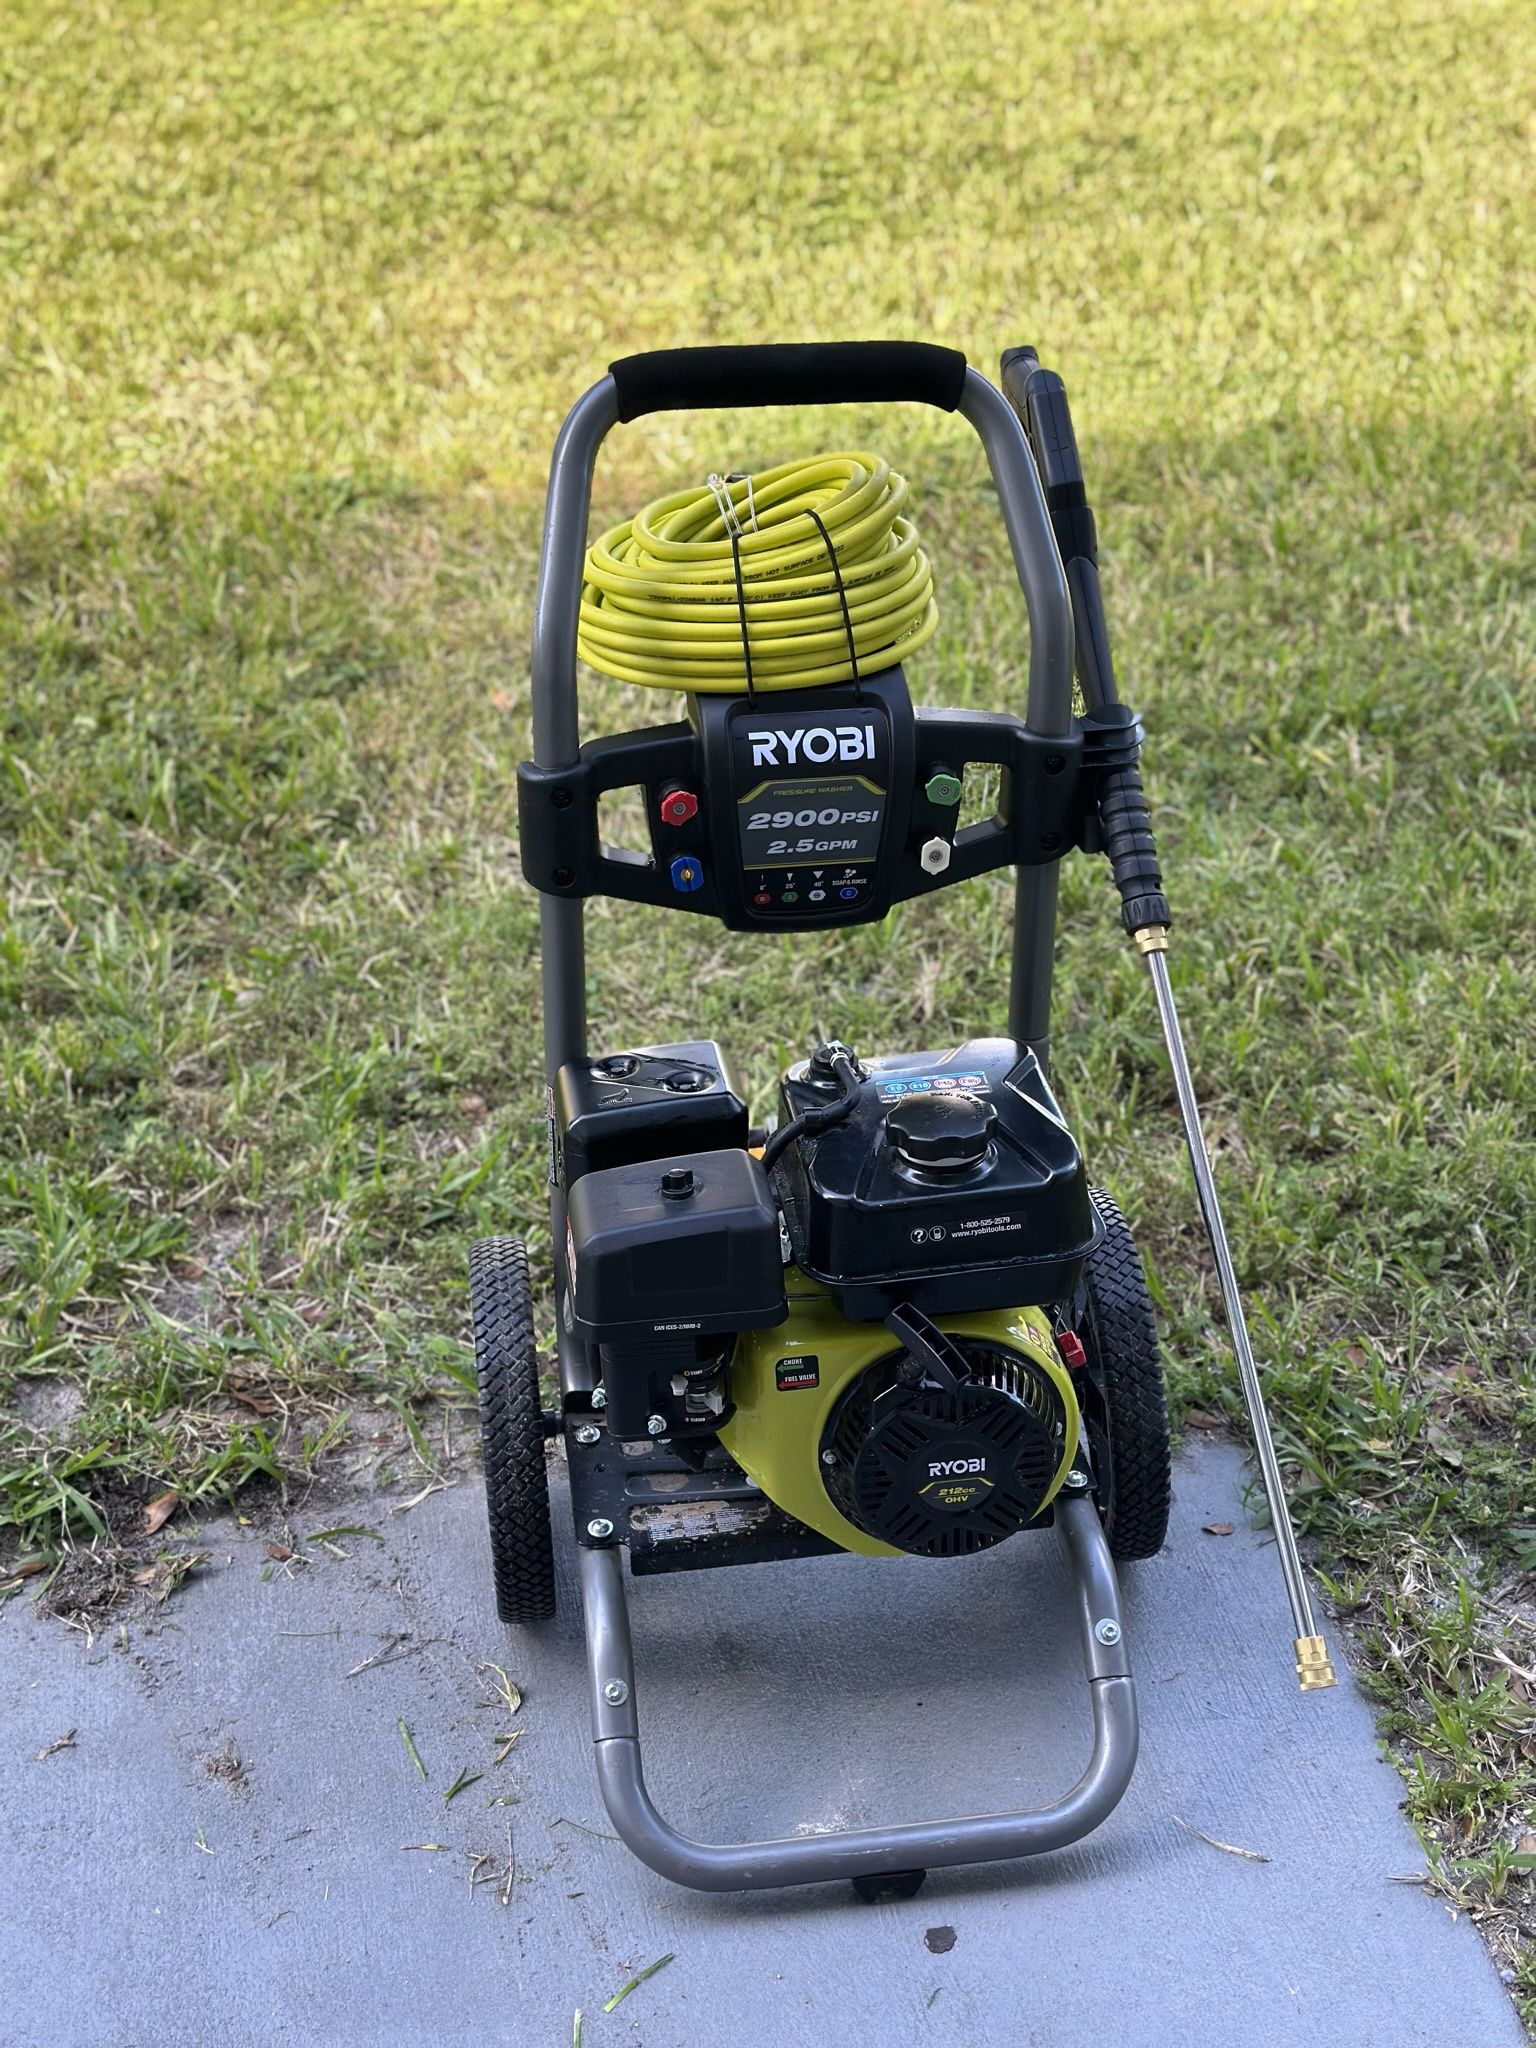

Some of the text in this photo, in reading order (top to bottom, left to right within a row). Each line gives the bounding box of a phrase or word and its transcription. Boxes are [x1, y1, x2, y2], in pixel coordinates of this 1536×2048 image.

[744, 572, 763, 581] FROM
[766, 568, 780, 577] HOT
[783, 557, 814, 572] SURFACE
[748, 725, 876, 766] RYOBI
[773, 785, 854, 796] PRESSURE WASHER
[951, 1223, 1022, 1238] www.ryobitools.com
[960, 1216, 1011, 1230] 1-800-525-2579
[928, 1457, 986, 1477] RYOBI
